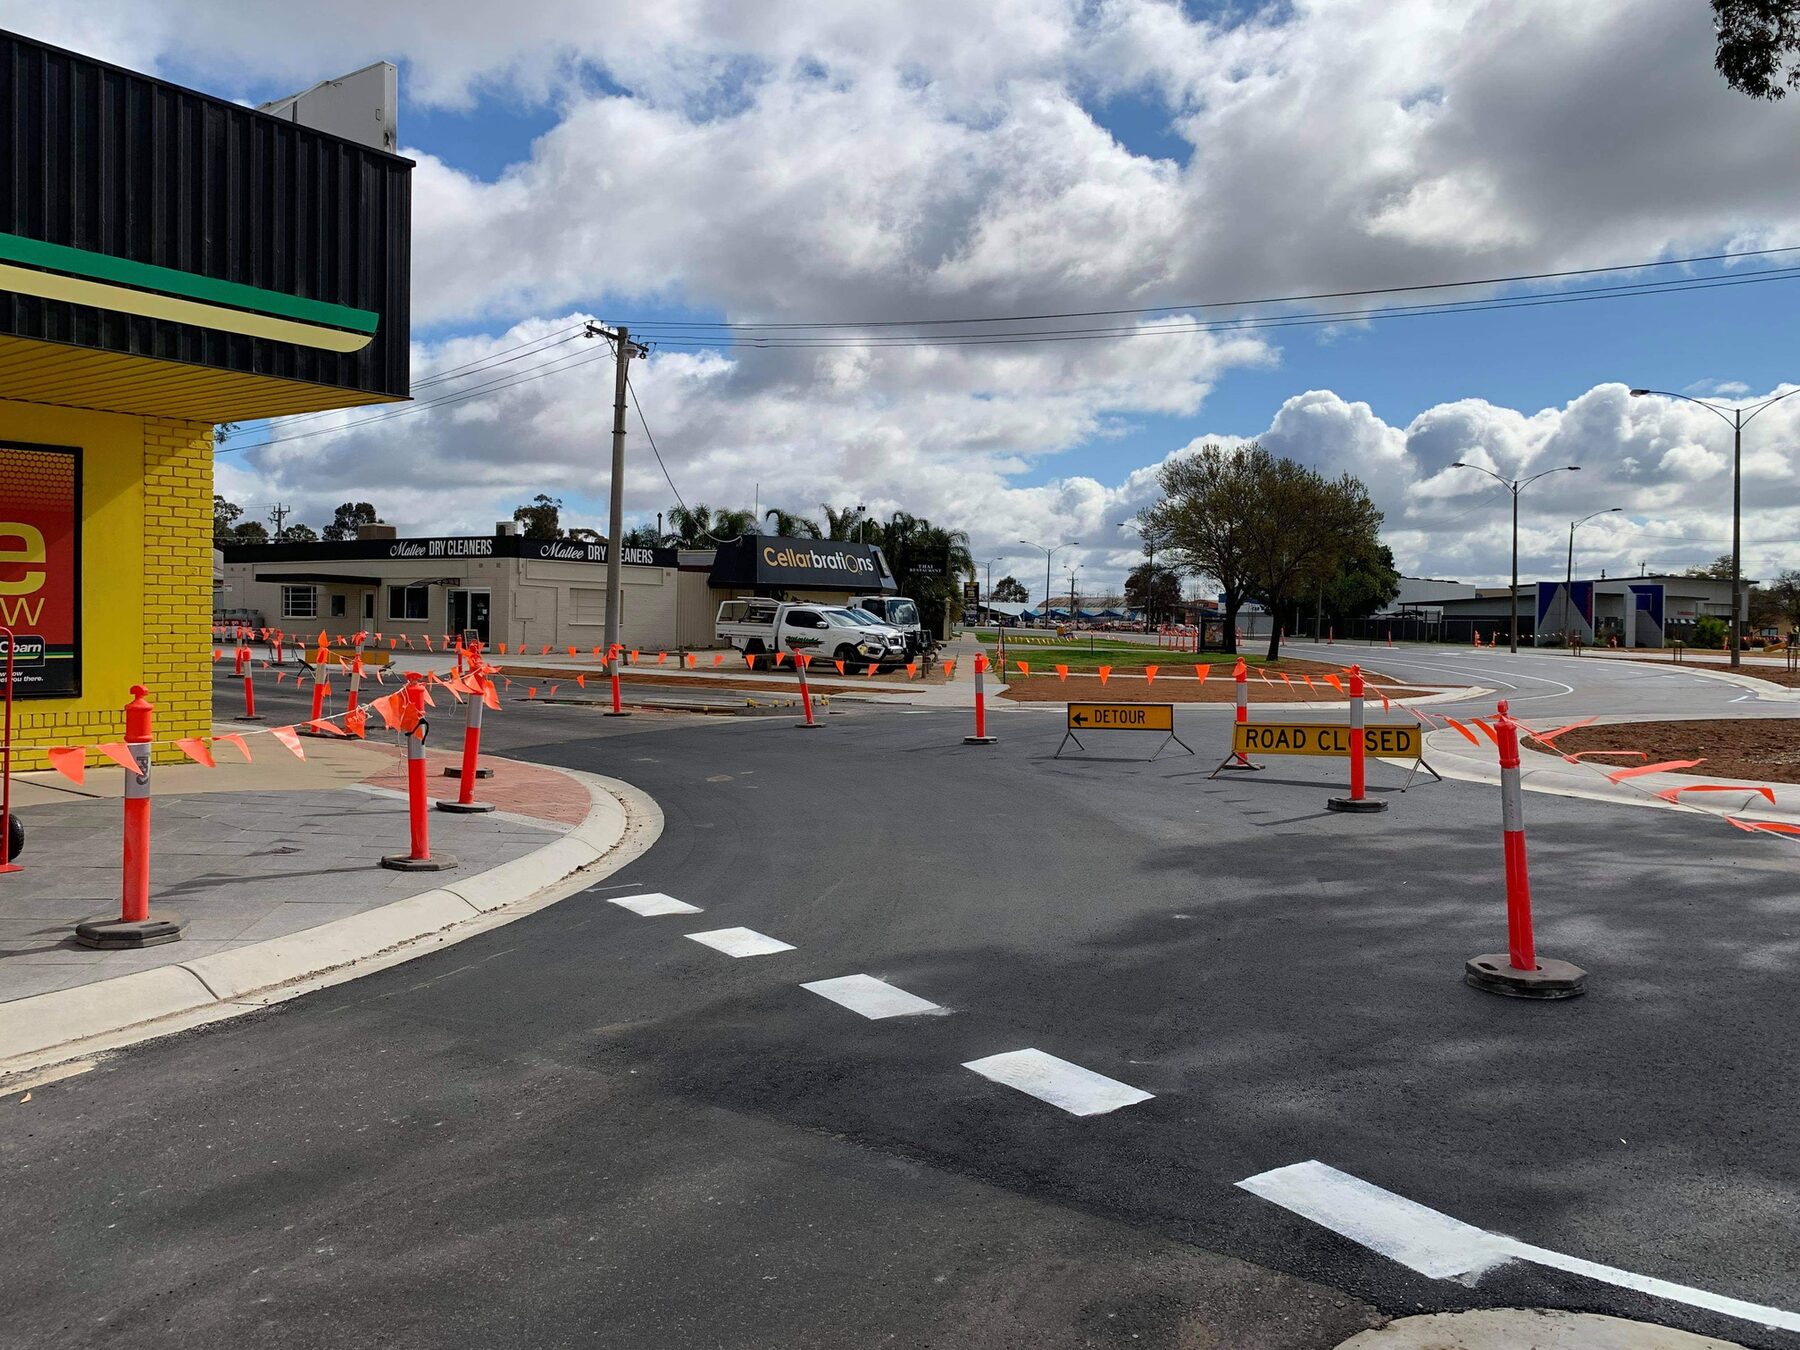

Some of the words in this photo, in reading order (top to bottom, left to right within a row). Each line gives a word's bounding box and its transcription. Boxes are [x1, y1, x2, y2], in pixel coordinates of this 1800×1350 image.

[389, 541, 425, 557] Mallee
[429, 541, 446, 555] DRY
[447, 540, 493, 555] CLEANERS
[540, 542, 584, 559] Mallee
[587, 545, 607, 560] DRY
[620, 547, 653, 564] EANERS
[763, 546, 874, 574] Cellarbrations
[1094, 709, 1146, 724] DETOUR
[1245, 729, 1306, 749] ROAD
[1317, 731, 1411, 752] CLSED
